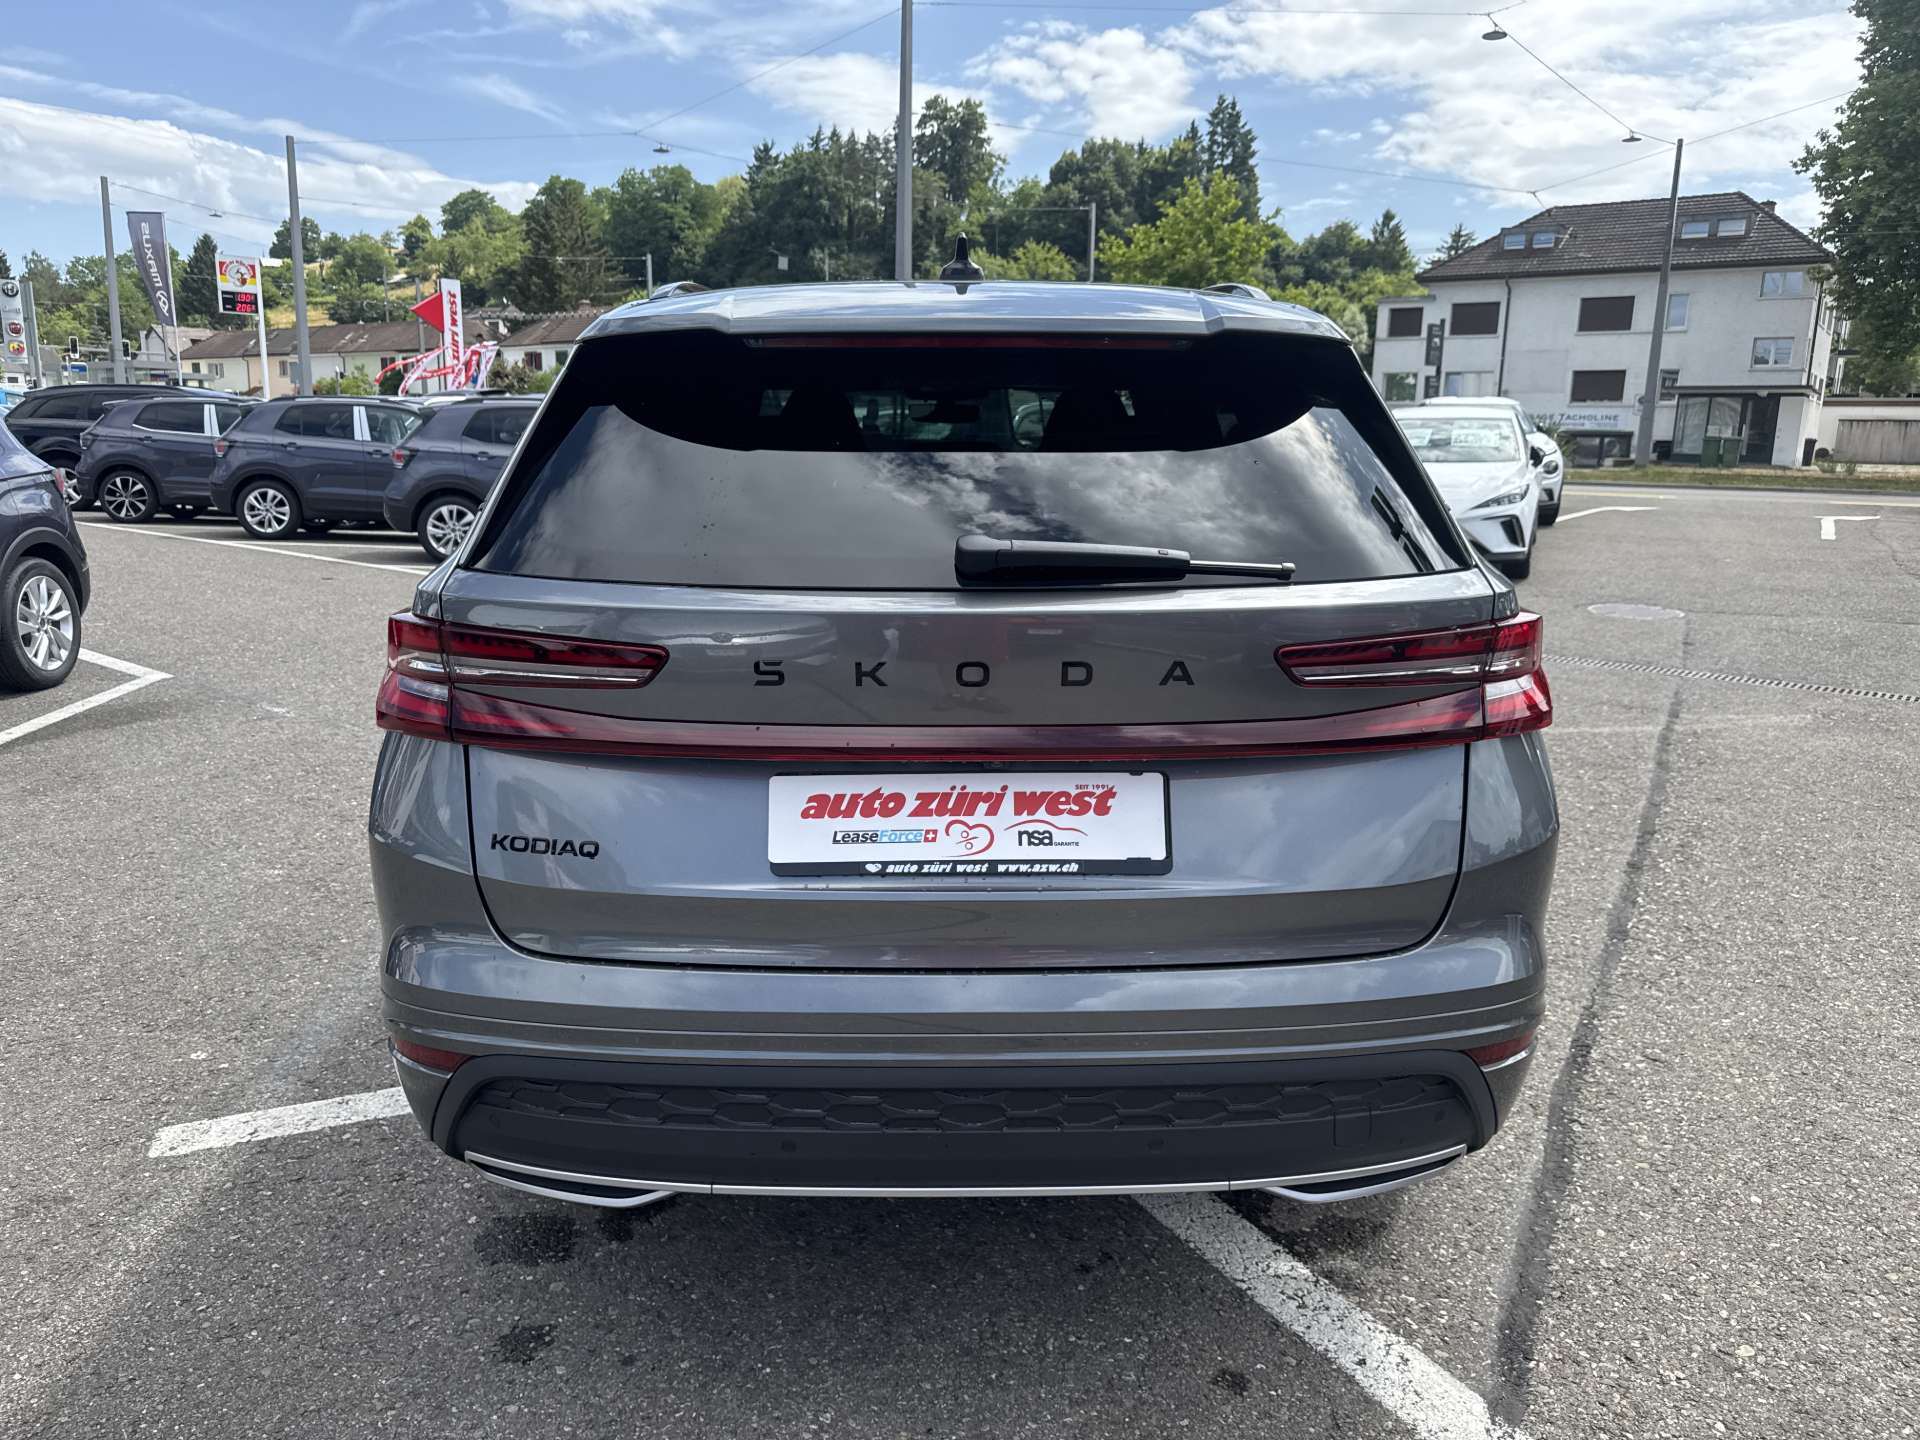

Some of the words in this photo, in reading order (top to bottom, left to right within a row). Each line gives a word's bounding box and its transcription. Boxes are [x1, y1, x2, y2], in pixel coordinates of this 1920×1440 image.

[448, 290, 458, 327] west
[1560, 413, 1619, 422] TACHOLINE
[801, 786, 906, 819] auto
[907, 785, 1009, 817] züri
[1013, 785, 1118, 816] west
[832, 829, 923, 844] LeaseForce
[1018, 830, 1053, 846] nsa
[491, 833, 600, 859] KODIAQ
[886, 863, 918, 873] auto
[922, 862, 953, 873] züri
[957, 863, 989, 873] west
[997, 862, 1079, 873] www.azw.ch
